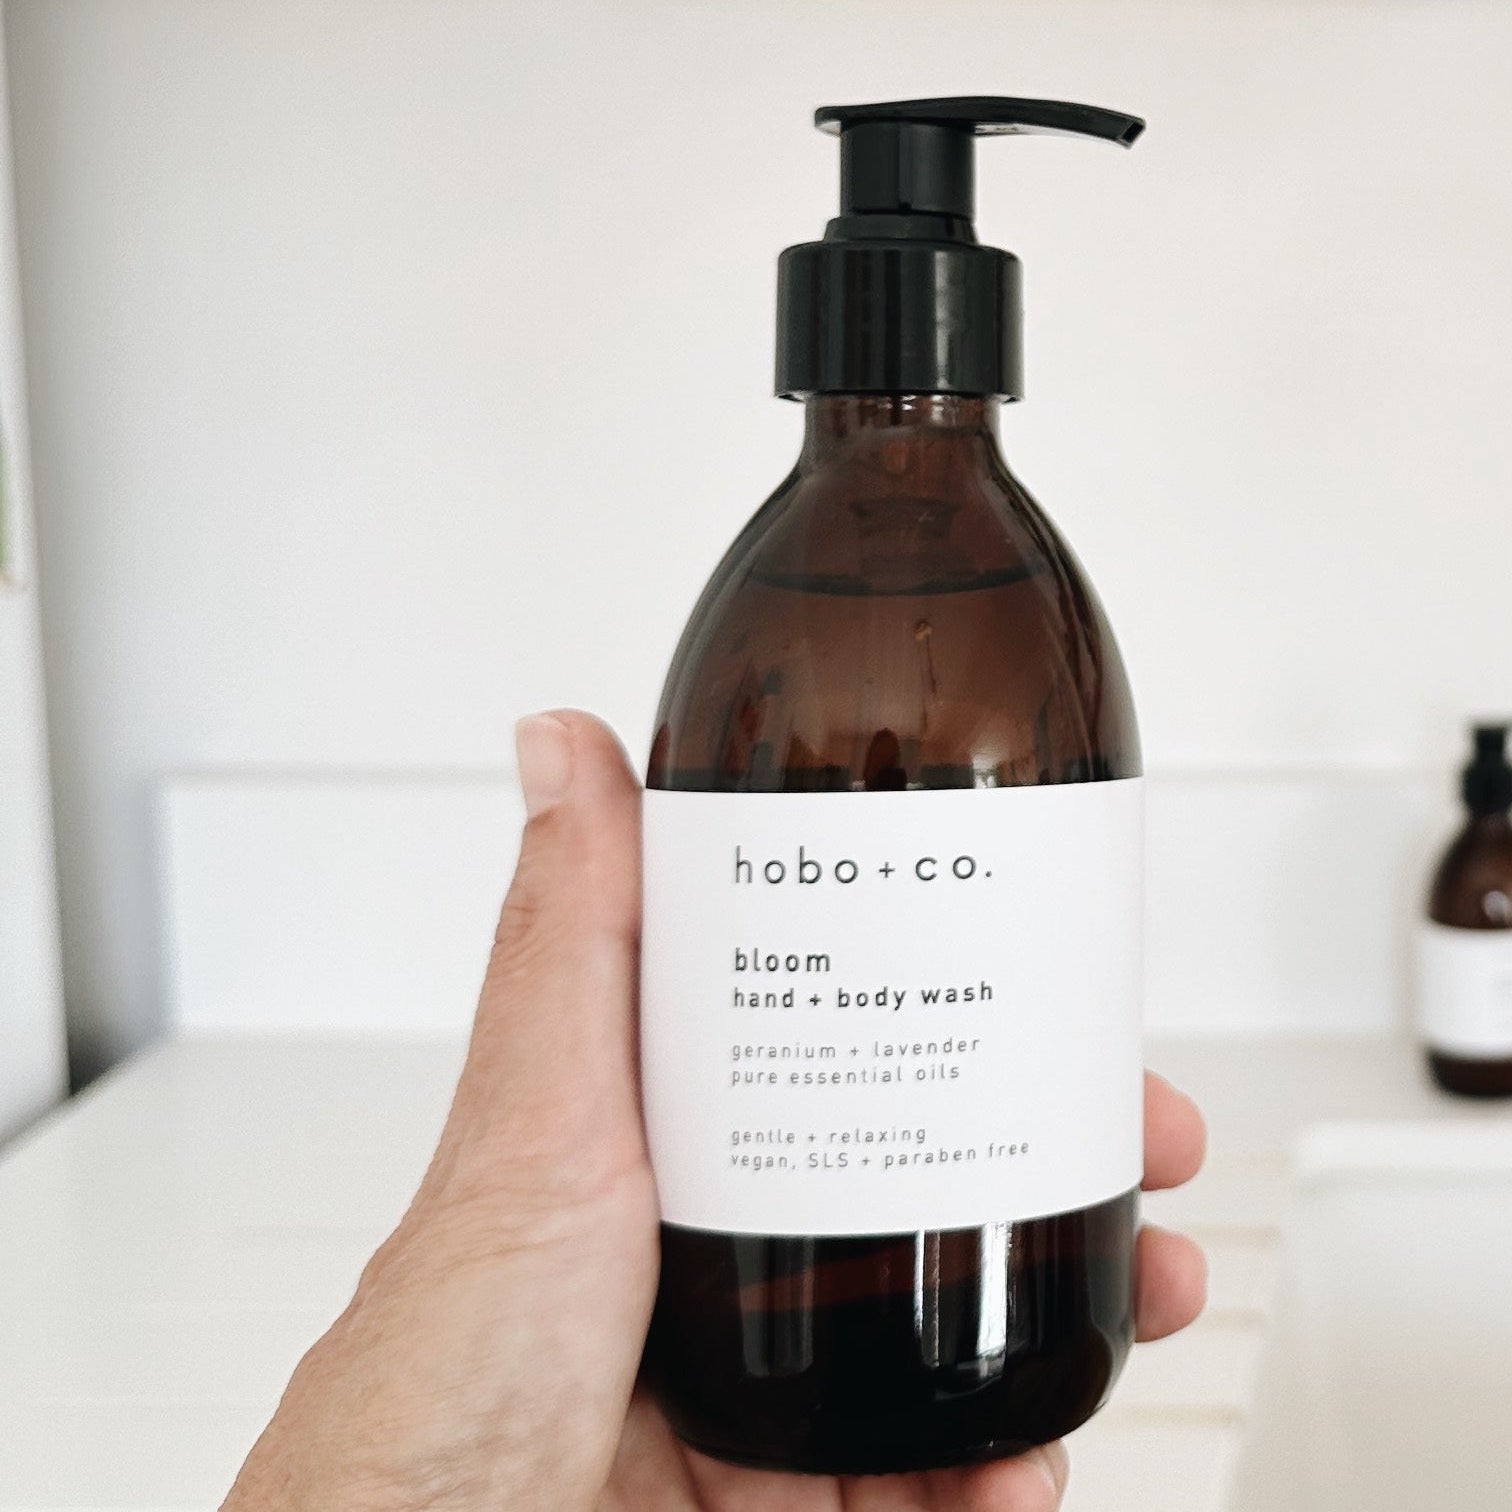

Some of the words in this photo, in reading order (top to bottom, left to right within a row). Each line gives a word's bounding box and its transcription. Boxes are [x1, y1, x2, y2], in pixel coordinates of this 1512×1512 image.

[735, 845, 859, 885] hobo
[878, 861, 896, 879] +
[914, 855, 992, 882] co.
[734, 947, 831, 973] bloom
[733, 986, 795, 1009] hand
[808, 993, 822, 1007] +
[837, 986, 907, 1012] body
[920, 980, 993, 1005] wash
[730, 1044, 837, 1063] geranium
[849, 1046, 860, 1057] +
[873, 1036, 981, 1058] lavender
[730, 1070, 778, 1088] pure
[788, 1065, 903, 1086] essential
[914, 1062, 960, 1082] oils
[730, 1128, 796, 1147] gentle
[807, 1133, 817, 1143] +
[828, 1127, 926, 1146] relaxing
[730, 1154, 797, 1173] vegan,
[807, 1151, 849, 1170] SLS
[861, 1156, 871, 1167] +
[883, 1147, 977, 1171] paraben
[988, 1142, 1029, 1159] free
